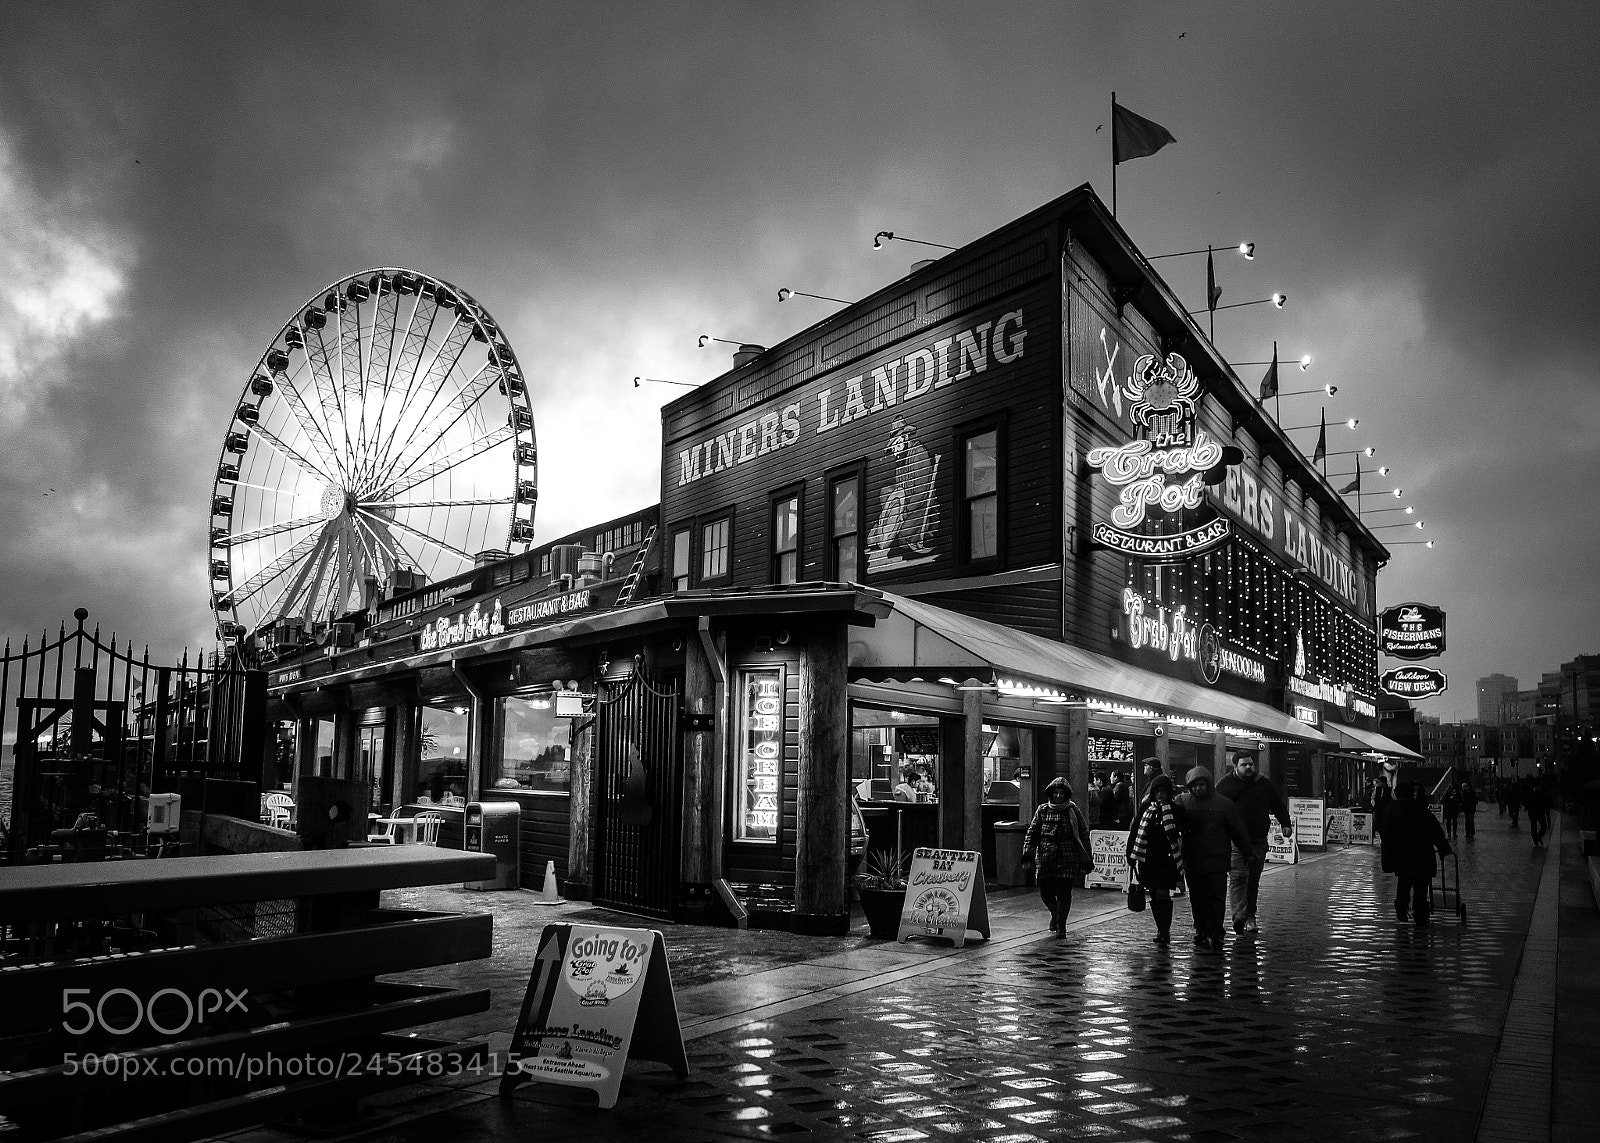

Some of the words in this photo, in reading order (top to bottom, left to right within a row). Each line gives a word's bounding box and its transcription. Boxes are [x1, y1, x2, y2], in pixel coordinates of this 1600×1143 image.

[677, 403, 801, 487] MINERS
[816, 308, 1028, 434] LANDING
[1155, 432, 1185, 447] the
[1086, 432, 1223, 485] Crab
[1111, 472, 1205, 529] Pot
[1096, 526, 1183, 553] RESTAURANT
[1185, 534, 1195, 548] &
[1197, 523, 1226, 543] BAR
[1284, 507, 1358, 607] LANDING
[508, 596, 561, 625] RESTAURANT
[560, 597, 568, 613] &
[568, 590, 590, 611] BAR
[436, 614, 465, 647] Crab
[464, 602, 489, 642] Pot
[1124, 588, 1169, 651] Crab
[1169, 604, 1197, 662] Pot
[1382, 628, 1442, 641] FISHERMANS
[1401, 623, 1423, 631] THE
[1386, 642, 1420, 650] Restaurant
[1388, 681, 1412, 691] VIEW
[1413, 681, 1437, 691] DECK
[1395, 671, 1430, 680] Outdoor
[754, 680, 780, 731] ICE
[752, 741, 779, 827] CREAM
[1095, 835, 1127, 849] OYSTER
[915, 849, 975, 862] SEATTLE
[932, 860, 955, 871] BAY
[572, 933, 619, 962] Going
[620, 939, 649, 964] to?
[571, 1024, 623, 1050] Landing
[542, 1058, 567, 1067] Entrance
[567, 1061, 586, 1069] Ahead
[553, 1067, 574, 1075] Seattle
[574, 1069, 602, 1078] Aquarium
